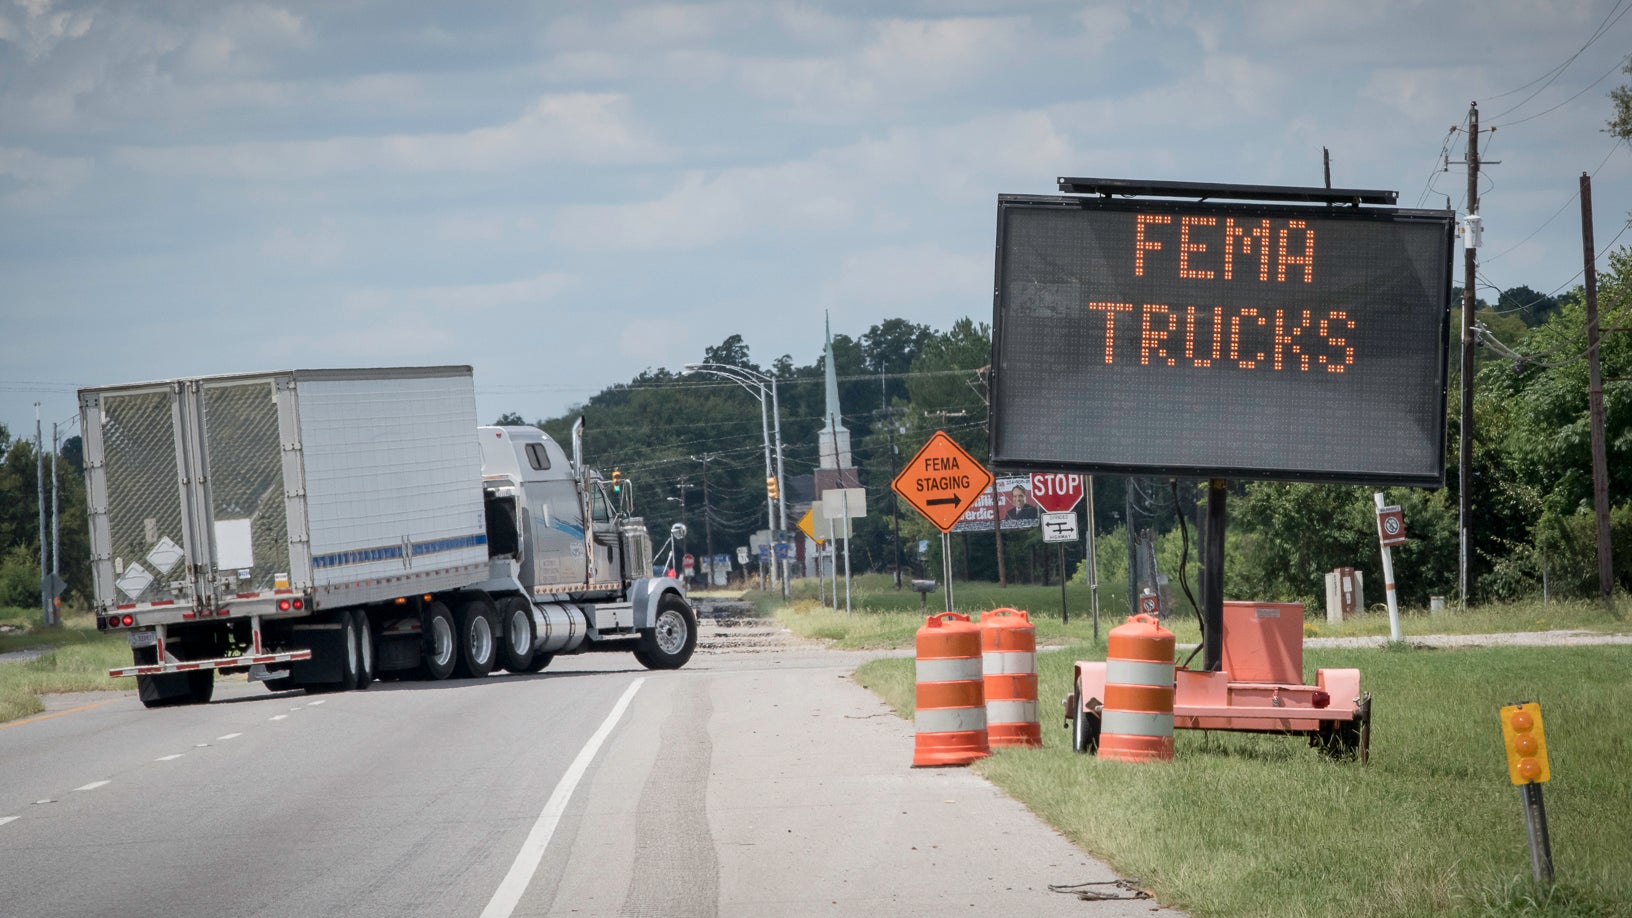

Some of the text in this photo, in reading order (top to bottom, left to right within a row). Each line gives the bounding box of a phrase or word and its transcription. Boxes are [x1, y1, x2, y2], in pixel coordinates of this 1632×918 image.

[1134, 214, 1316, 283] FEMA
[1088, 301, 1356, 374] TRUCKS
[924, 456, 960, 472] FEMA
[916, 475, 970, 492] STAGING
[1033, 474, 1080, 496] STOP
